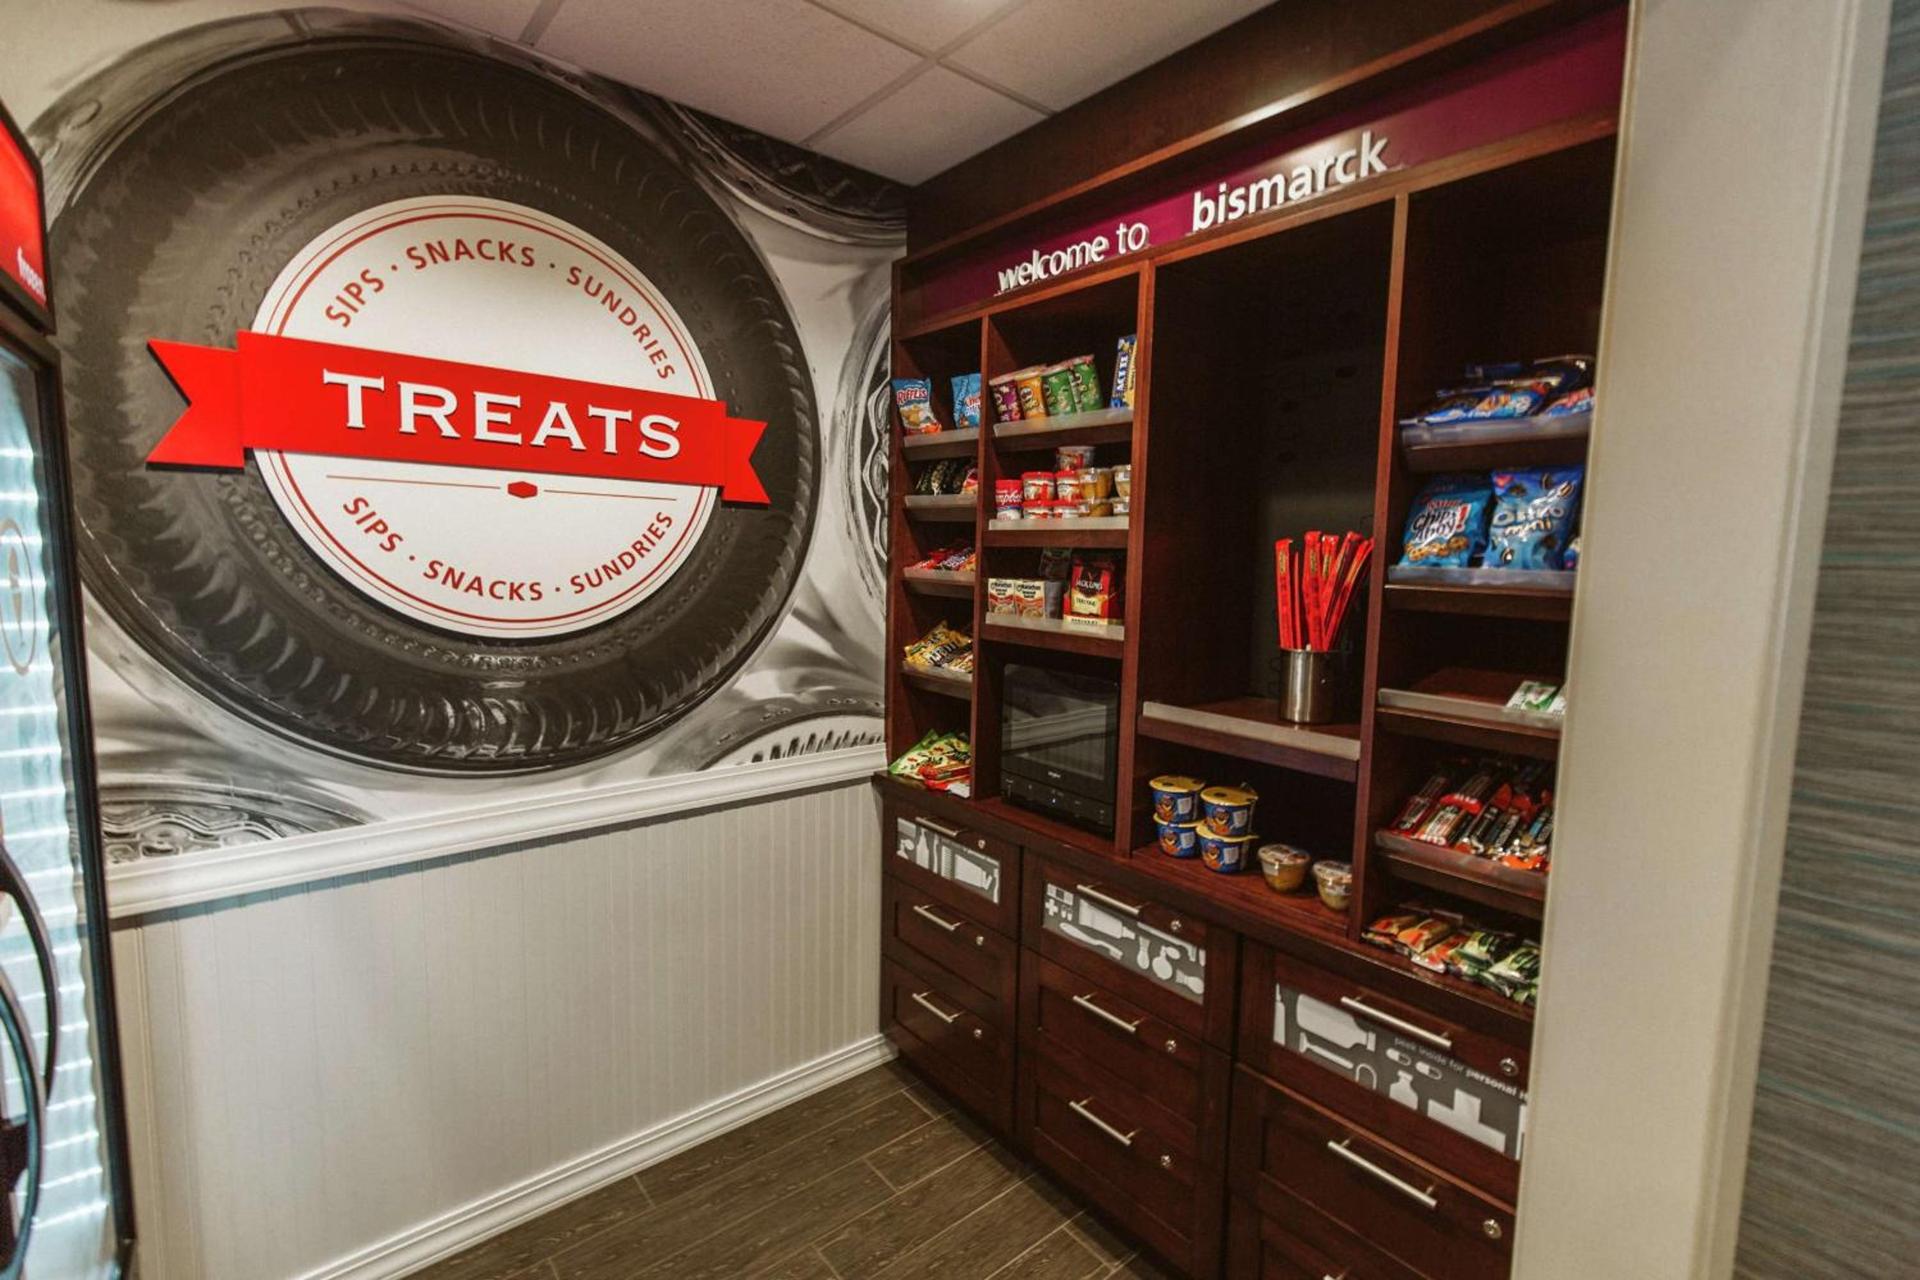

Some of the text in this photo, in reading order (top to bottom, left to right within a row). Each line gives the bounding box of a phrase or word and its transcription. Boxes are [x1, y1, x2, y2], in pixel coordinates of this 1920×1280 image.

[998, 130, 1389, 292] welcome to bismarck
[325, 238, 675, 380] SIPS SNACKS SUNDRIES
[322, 368, 682, 460] TREATS
[343, 497, 673, 601] SIPS SNACKS SUNDRIES
[1449, 1059, 1464, 1072] for
[1465, 1069, 1517, 1096] personal
